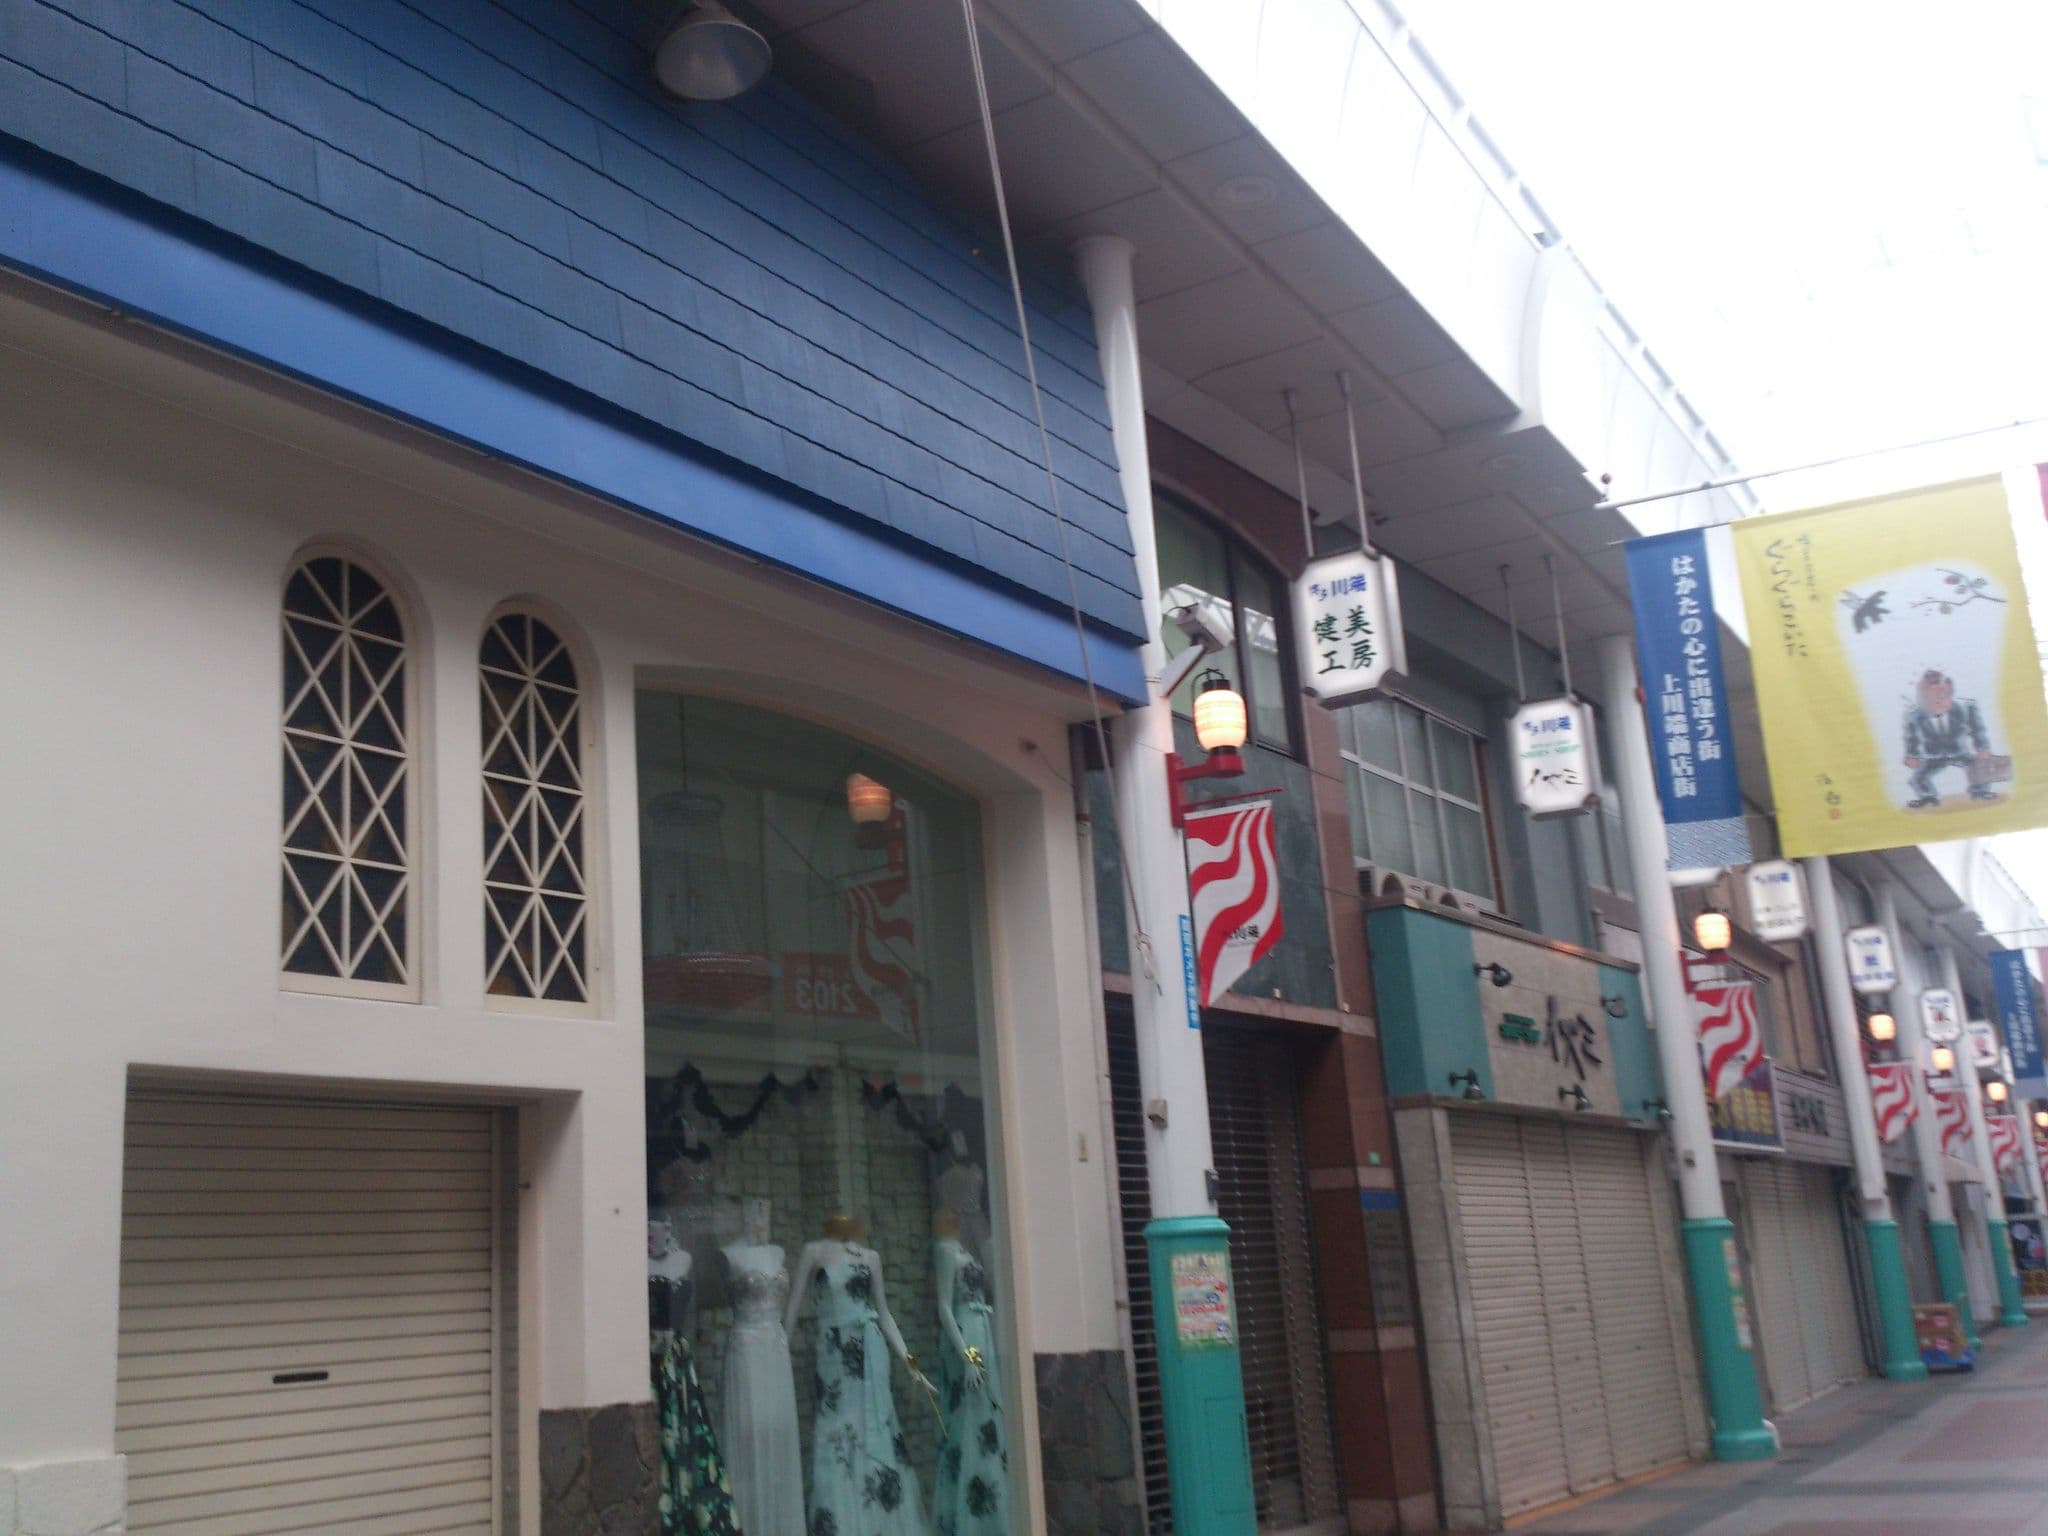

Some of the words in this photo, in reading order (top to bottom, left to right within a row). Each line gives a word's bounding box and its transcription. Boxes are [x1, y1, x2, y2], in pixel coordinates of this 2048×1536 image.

[1661, 674, 1697, 798] 上川端商店街
